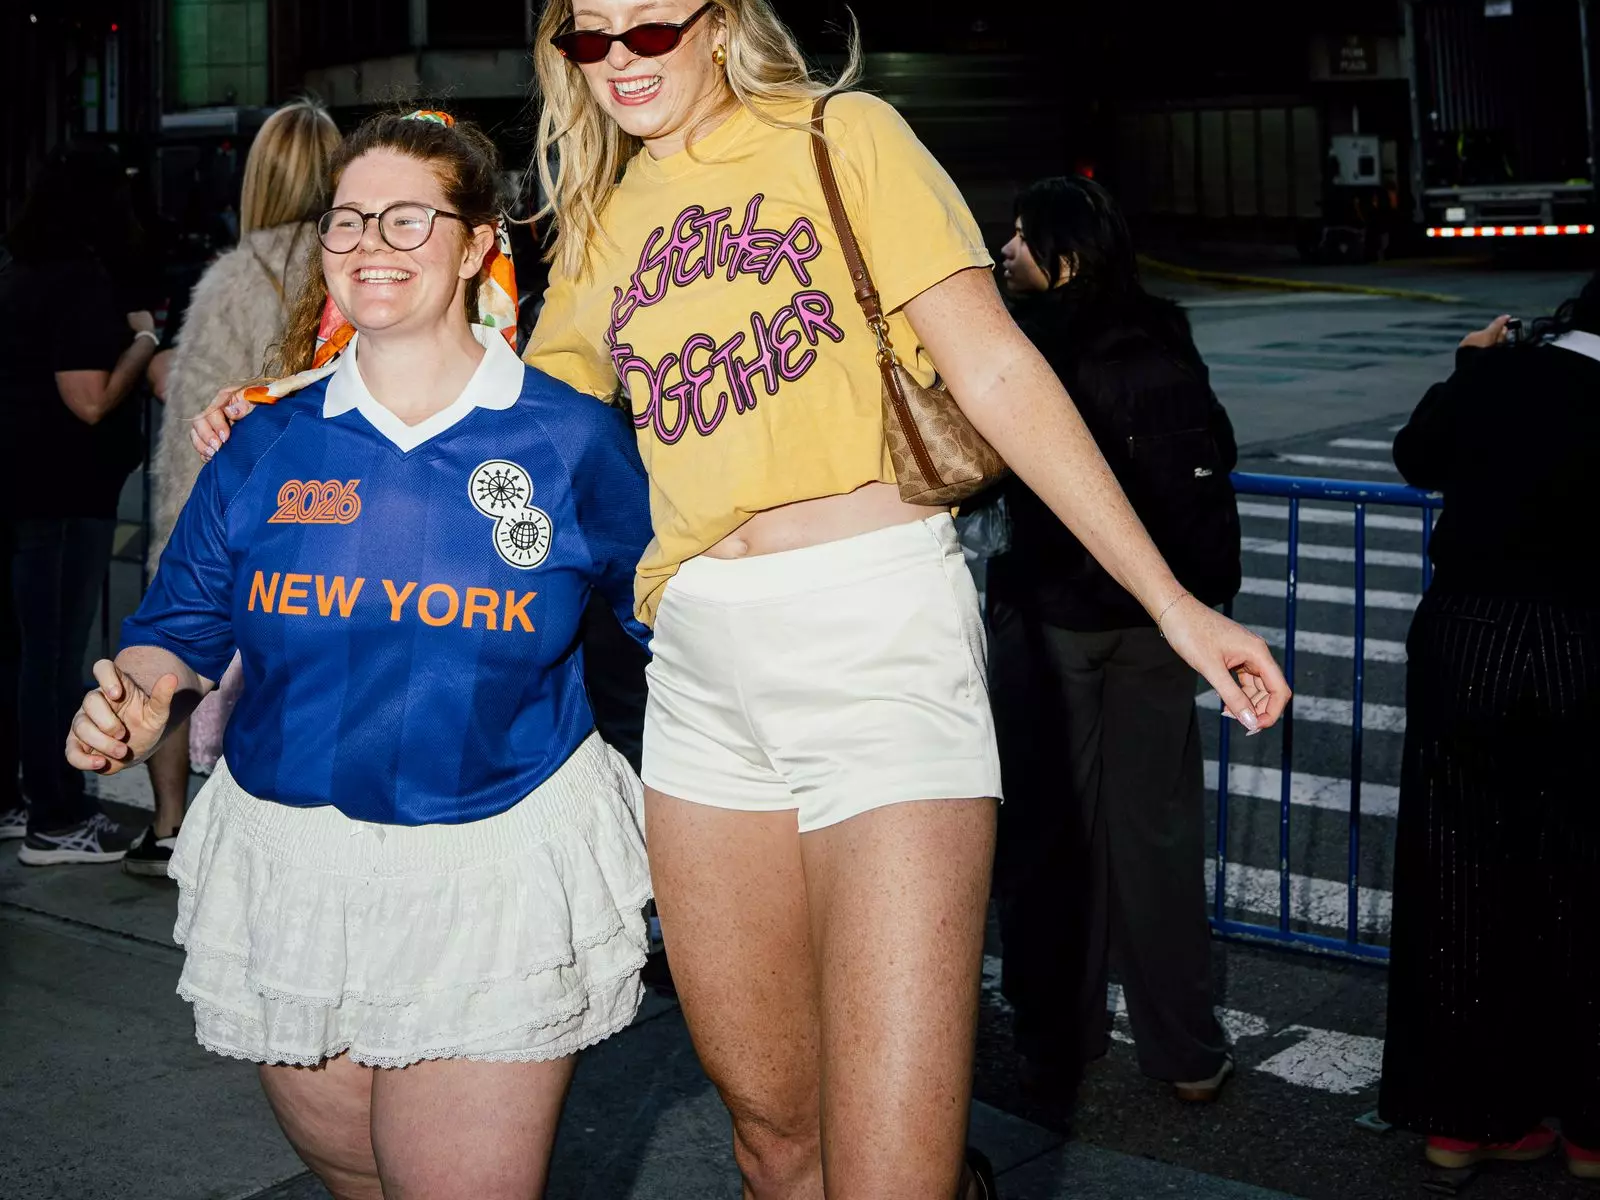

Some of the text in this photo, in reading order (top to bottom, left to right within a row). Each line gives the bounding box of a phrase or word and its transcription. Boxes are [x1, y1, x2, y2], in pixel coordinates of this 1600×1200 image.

[606, 193, 822, 332] OGETHER
[267, 479, 361, 524] 2026
[247, 570, 538, 633] NEW YORK
